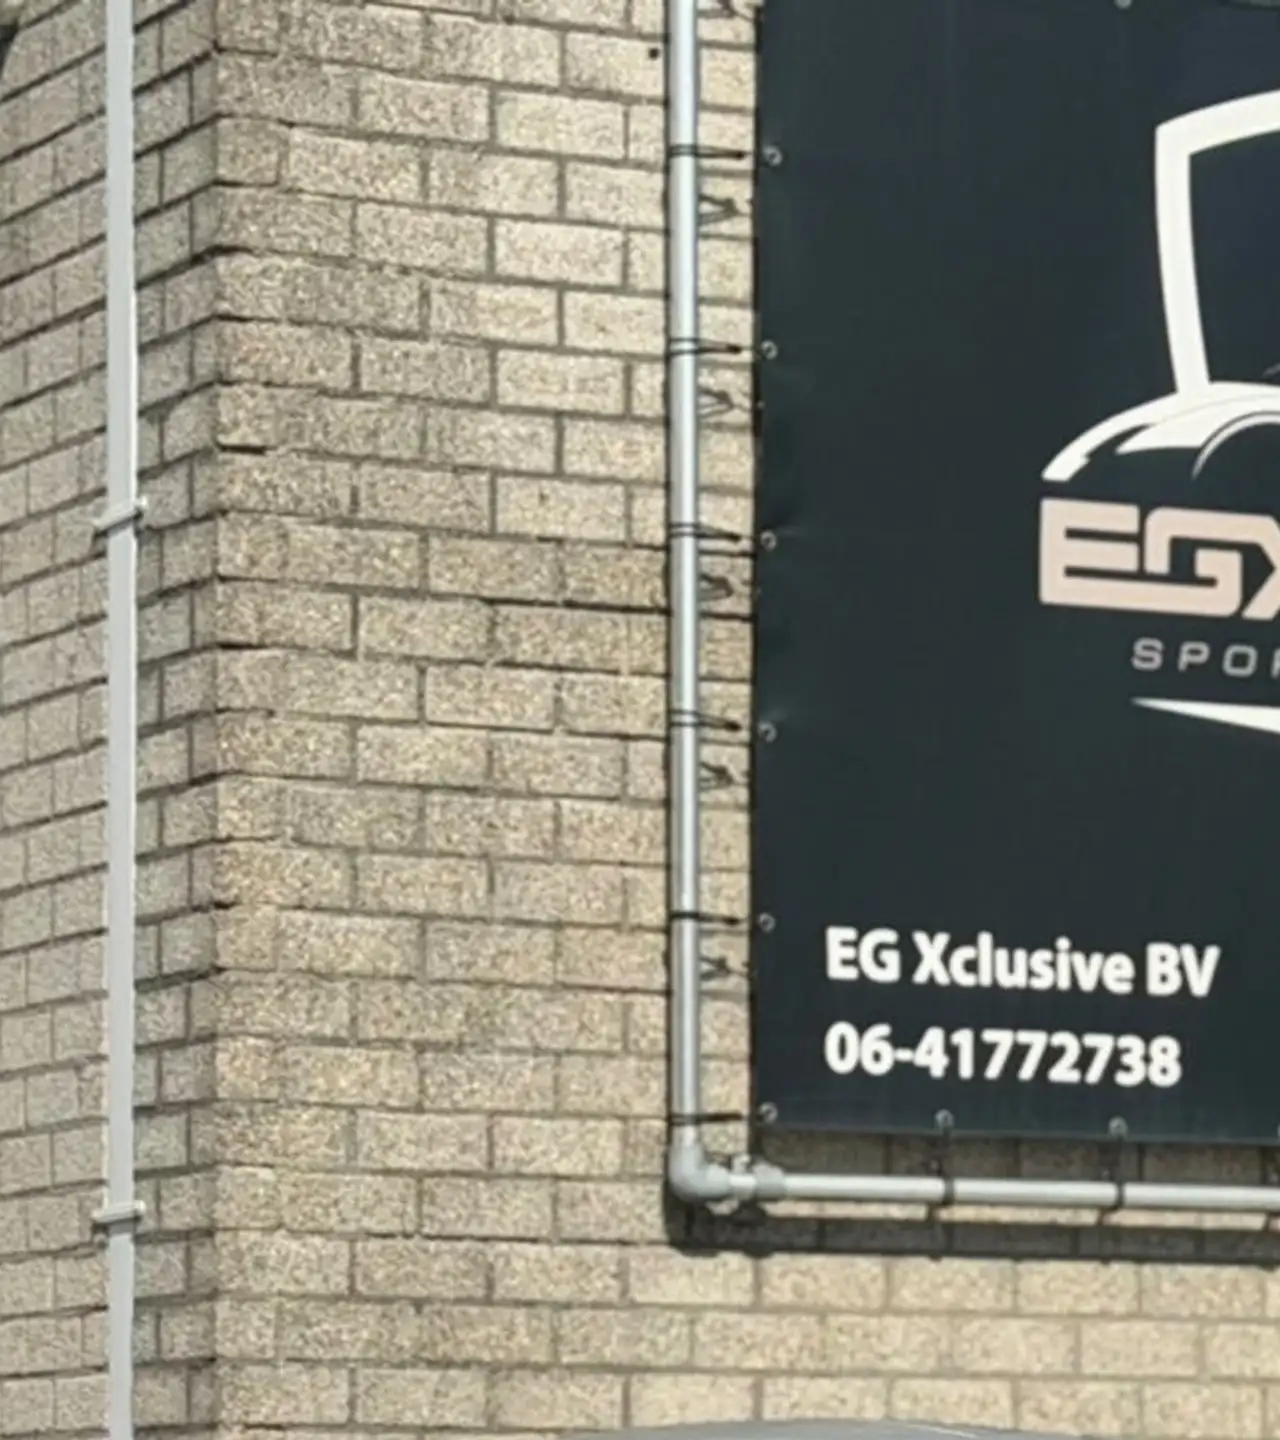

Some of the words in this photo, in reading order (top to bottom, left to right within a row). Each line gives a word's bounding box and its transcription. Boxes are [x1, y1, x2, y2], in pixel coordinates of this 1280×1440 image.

[825, 926, 901, 983] EG
[912, 931, 1136, 994] Xclusive
[1146, 941, 1220, 998] BV
[824, 1021, 1182, 1088] 06-41772738
